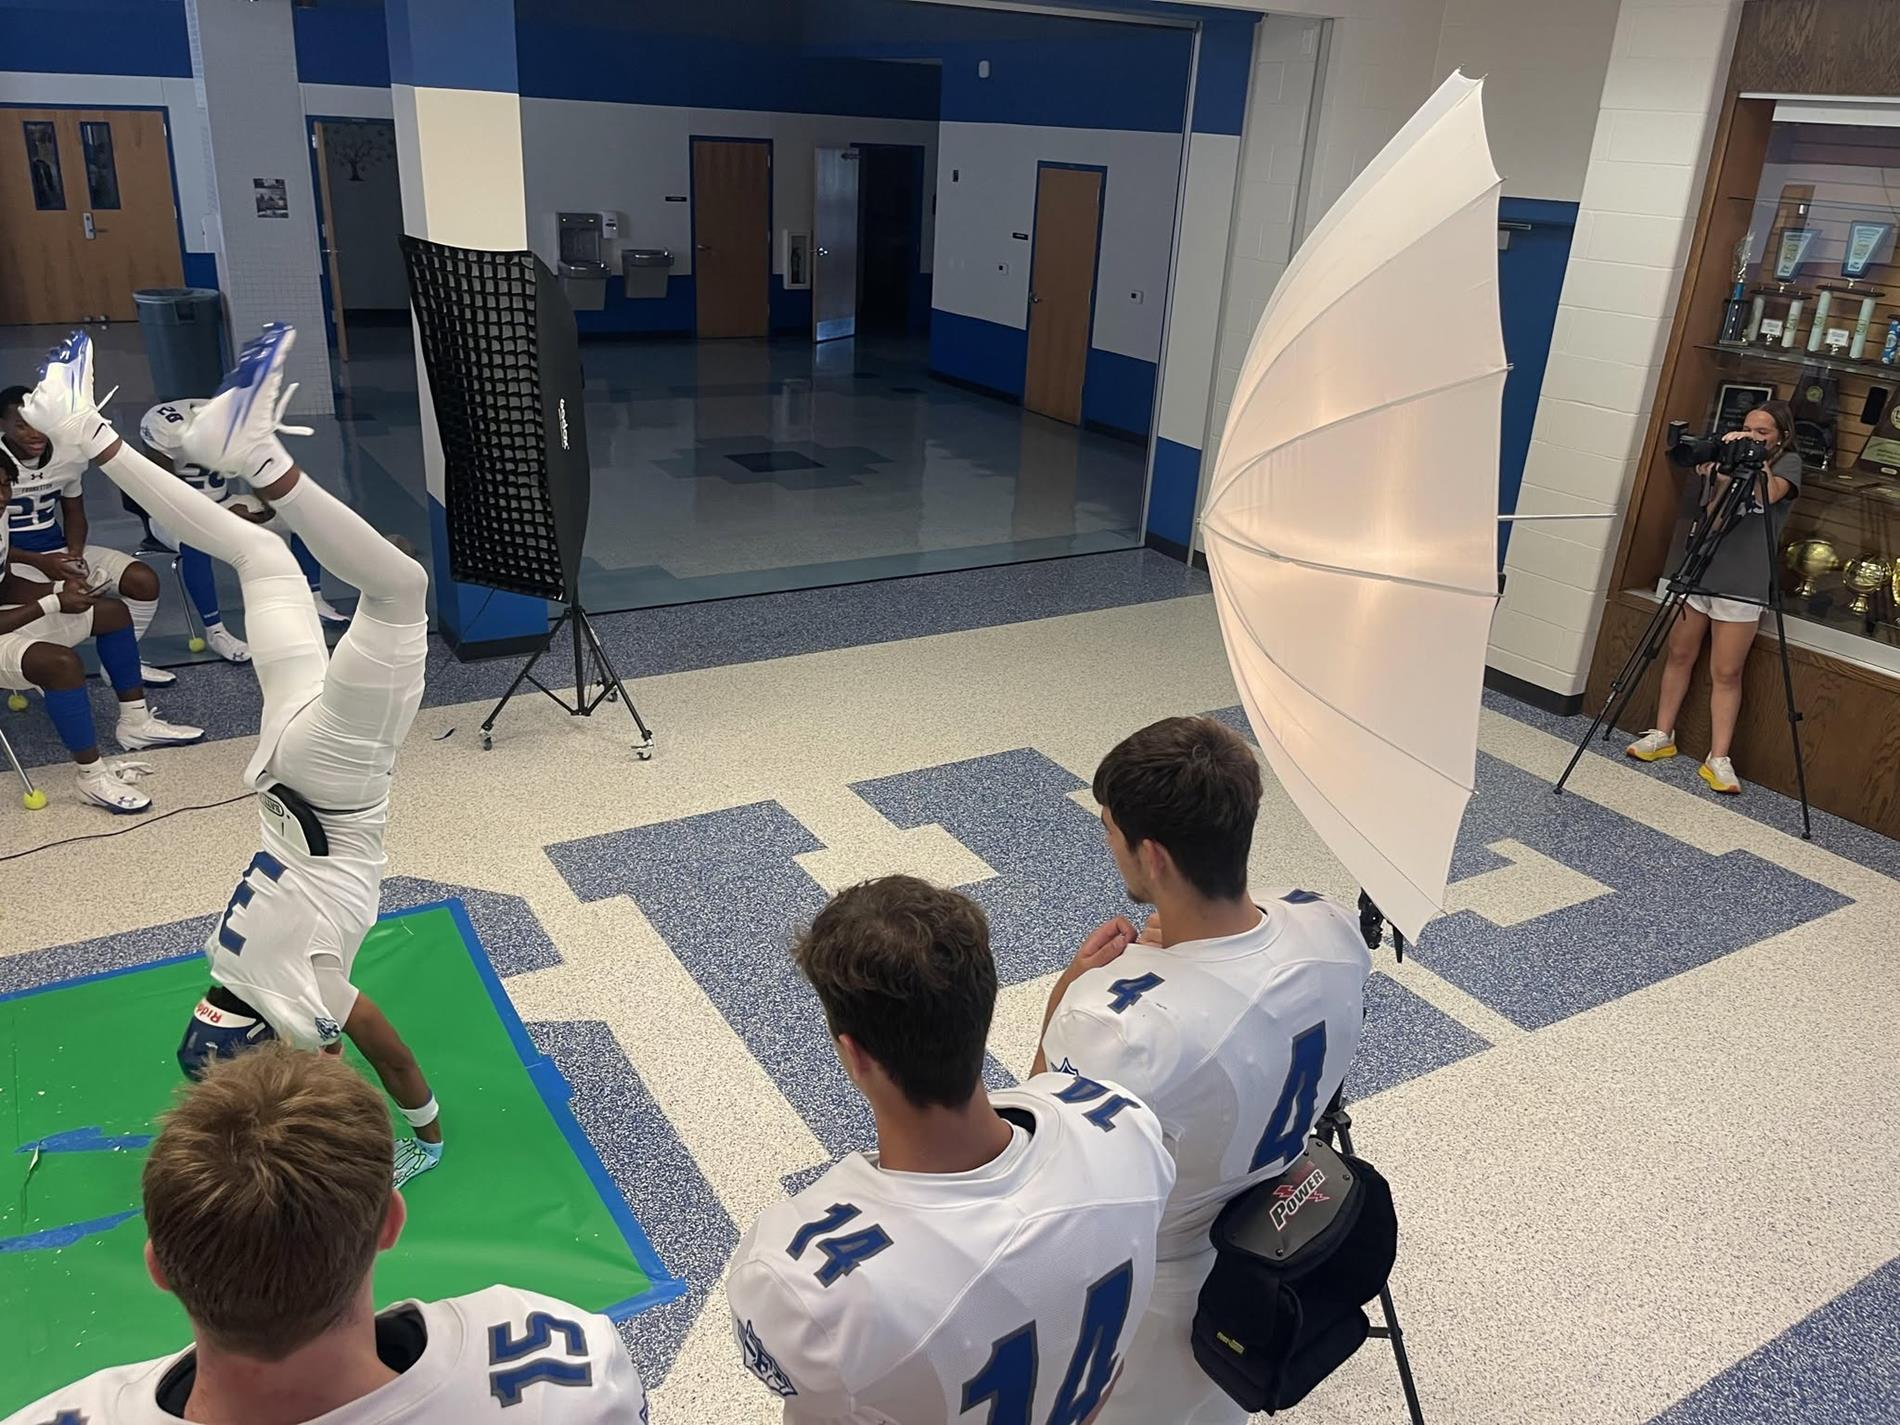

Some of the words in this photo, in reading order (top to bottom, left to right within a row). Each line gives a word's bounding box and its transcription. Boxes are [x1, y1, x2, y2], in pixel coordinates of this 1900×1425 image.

[1107, 971, 1165, 1014] 4
[1247, 1019, 1328, 1174] 4
[786, 1202, 895, 1288] 14
[487, 1310, 593, 1408] 15
[959, 1257, 1134, 1425] 14
